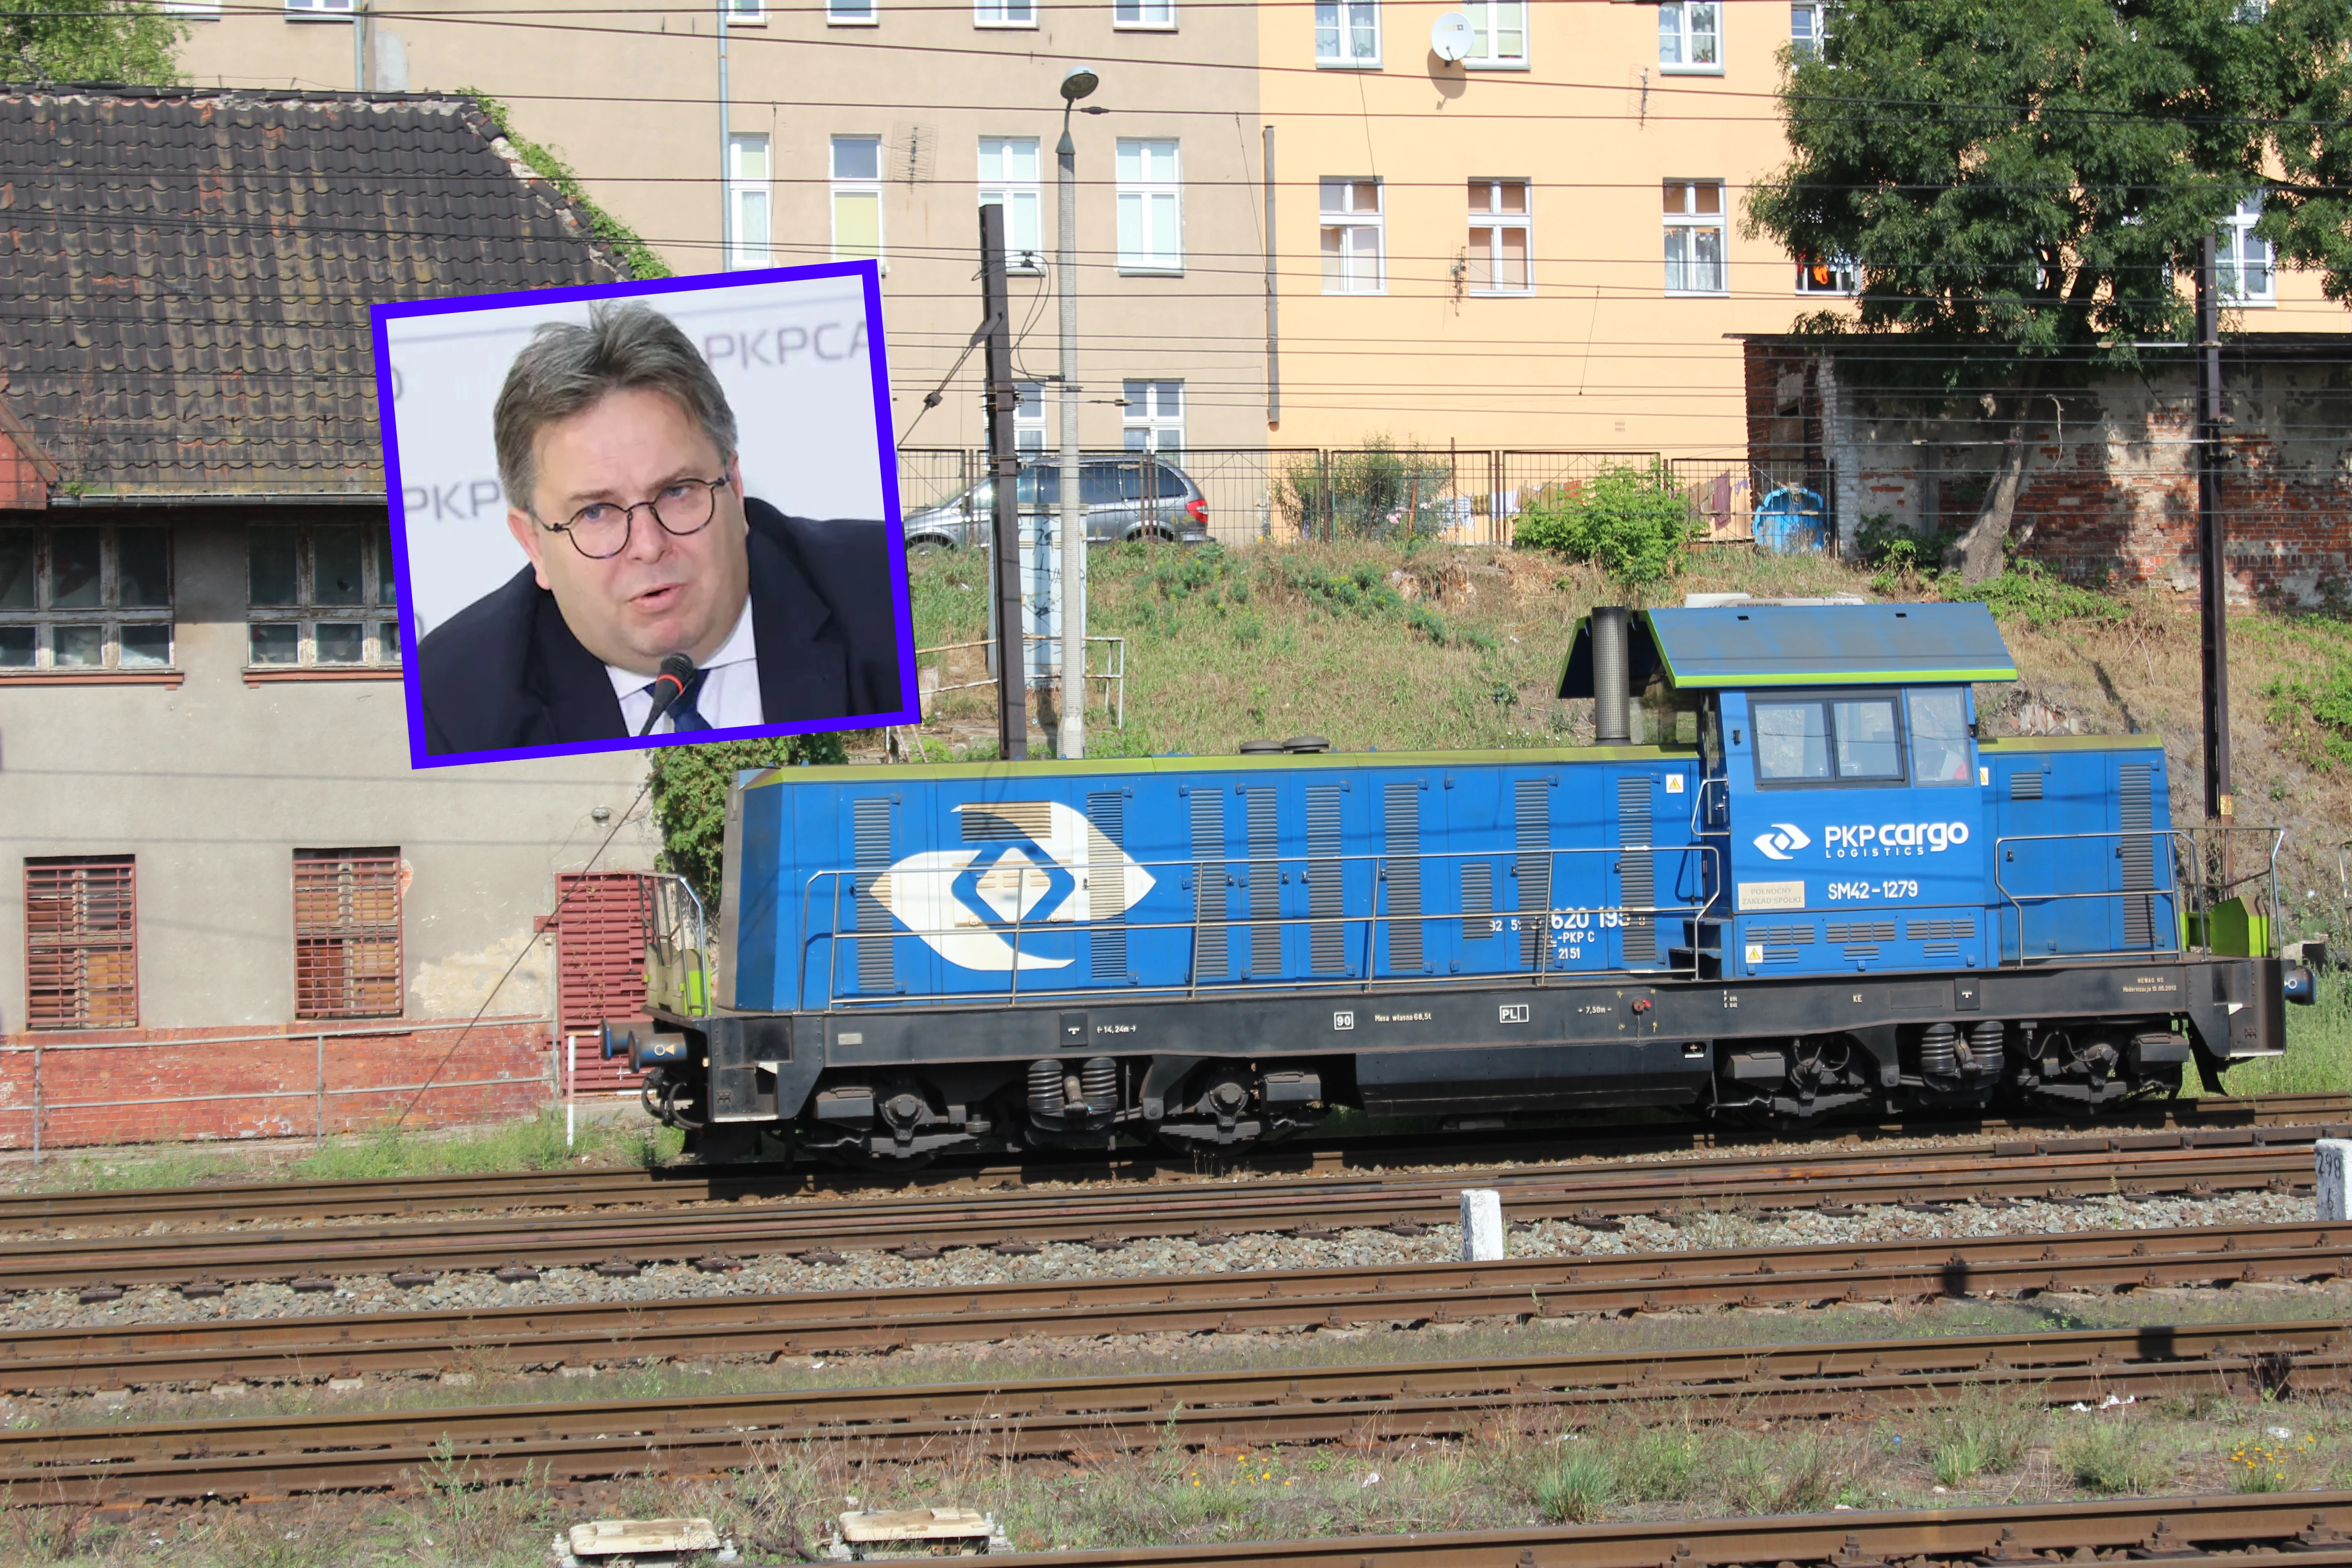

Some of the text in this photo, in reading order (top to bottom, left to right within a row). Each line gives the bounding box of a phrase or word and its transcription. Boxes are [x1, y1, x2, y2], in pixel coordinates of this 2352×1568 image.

[1826, 847, 1924, 858] LOGISTICS
[1751, 887, 1792, 895] PÓŁNOCNY
[1828, 880, 1918, 901] SM42-1279
[1774, 896, 1801, 904] SPÓŁKI
[1551, 906, 1590, 930] 620
[1853, 995, 1862, 1003] KE
[1502, 1009, 1517, 1019] PL
[1585, 1006, 1606, 1014] 7,50m
[1337, 1016, 1351, 1026] 90
